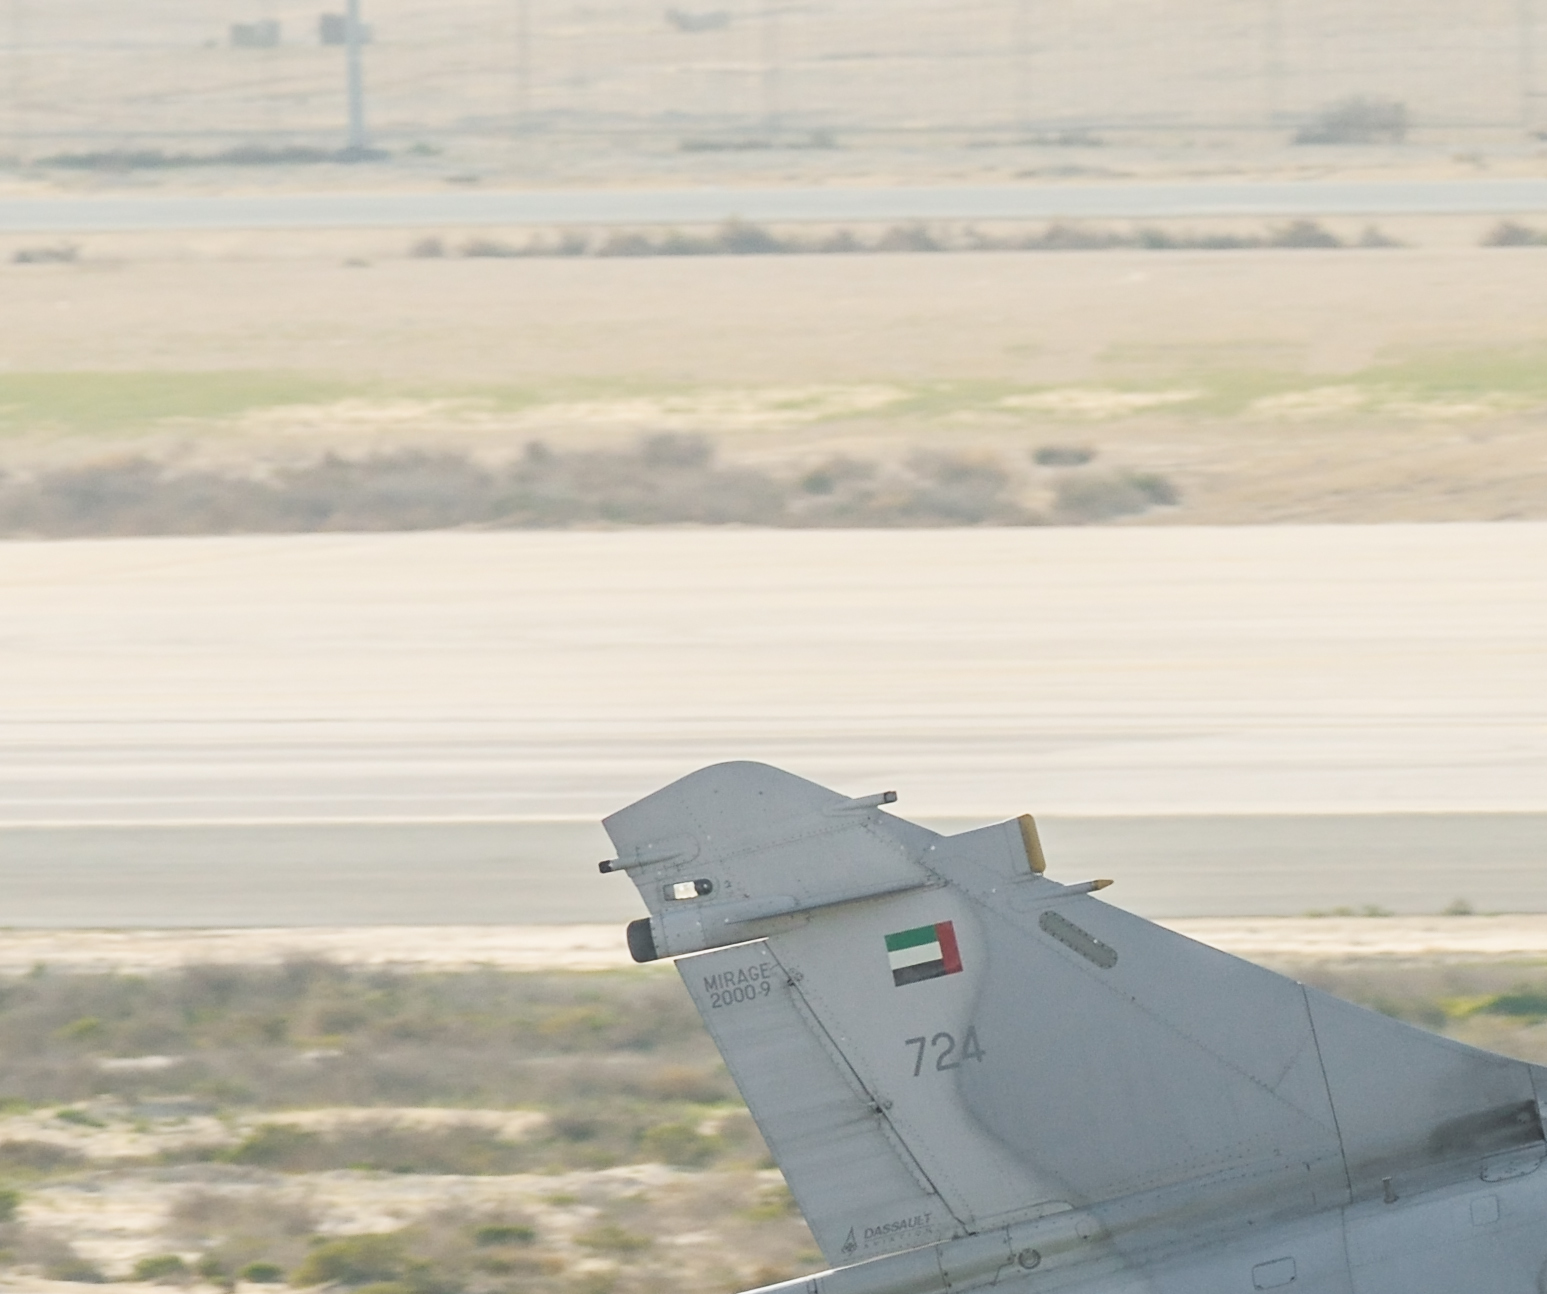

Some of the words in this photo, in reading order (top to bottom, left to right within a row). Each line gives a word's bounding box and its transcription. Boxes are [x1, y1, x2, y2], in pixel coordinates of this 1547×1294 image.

[703, 962, 771, 992] MIRAGE
[710, 981, 771, 1008] 2000-9
[905, 1025, 986, 1077] 724
[864, 1212, 932, 1239] DASSAULT
